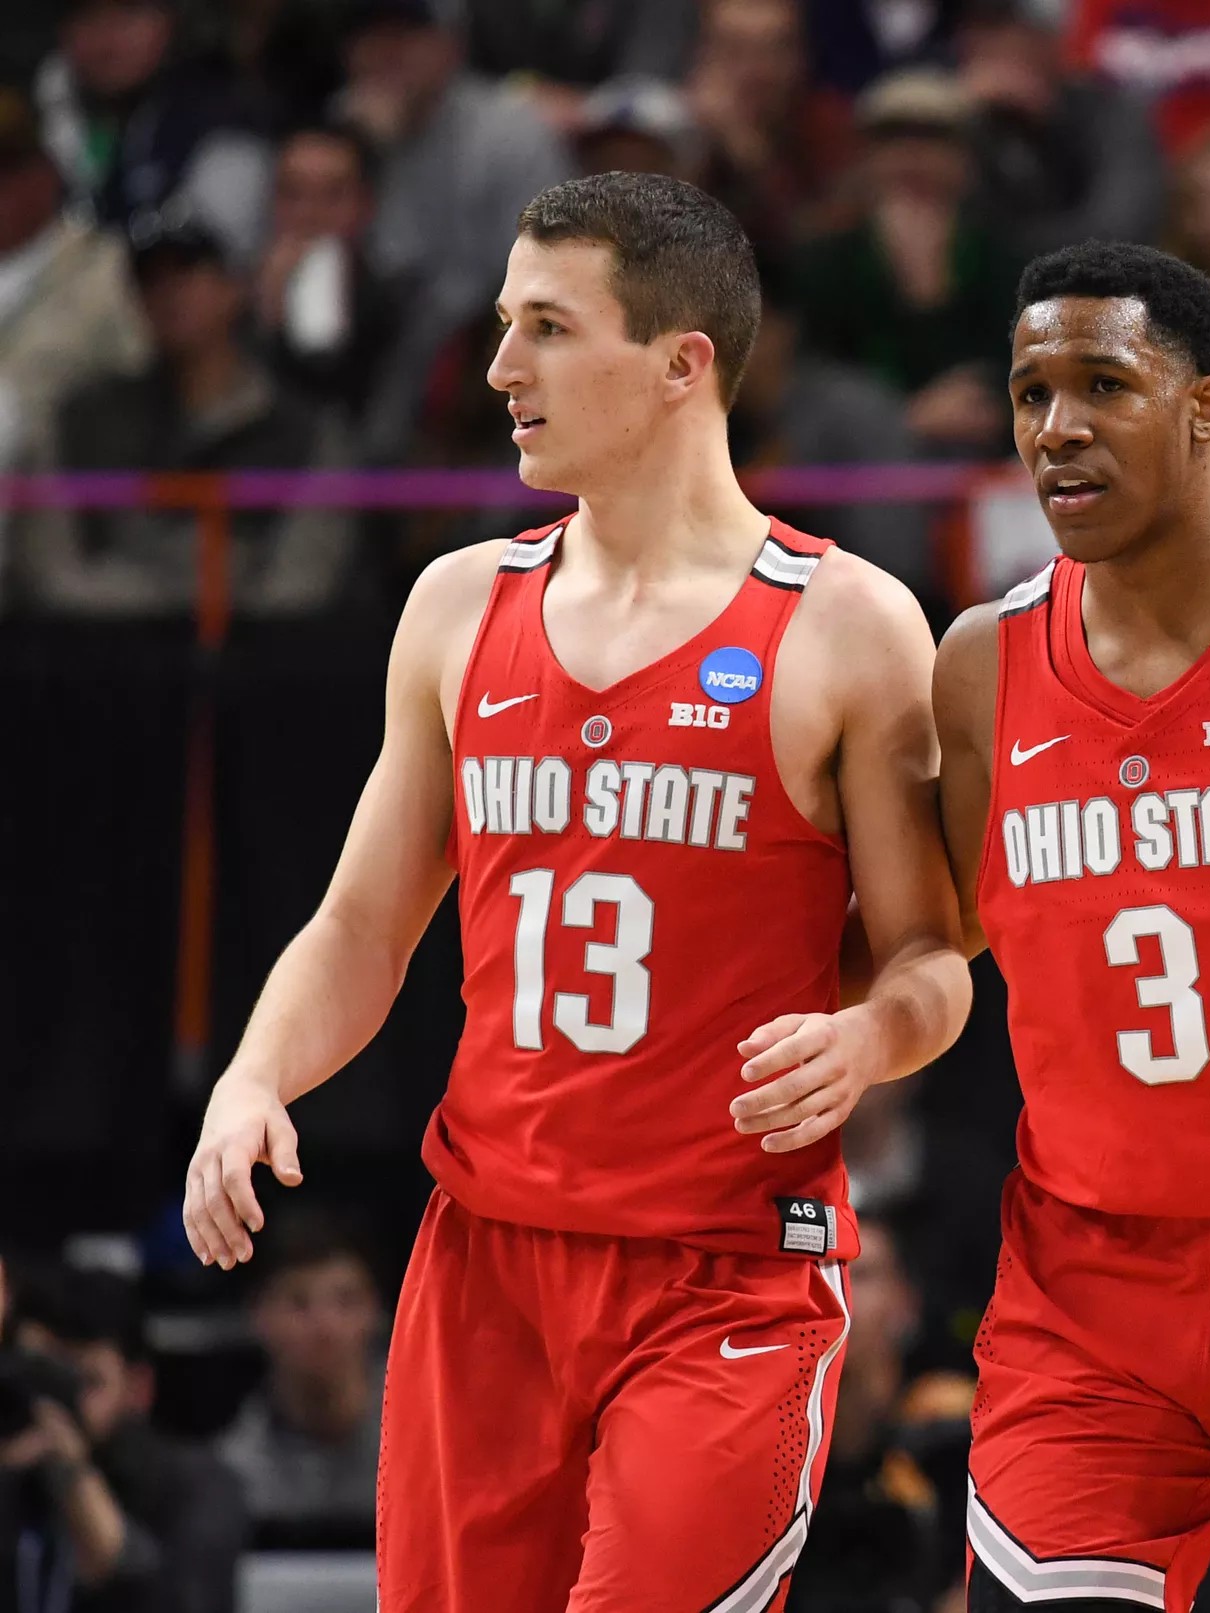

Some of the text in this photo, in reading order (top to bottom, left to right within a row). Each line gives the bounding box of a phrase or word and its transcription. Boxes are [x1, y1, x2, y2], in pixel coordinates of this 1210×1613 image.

[706, 671, 758, 691] NCAA
[461, 755, 757, 852] OHIO STATE
[1002, 796, 1122, 888] OHIO
[509, 868, 655, 1055] 13
[789, 1202, 817, 1219] 46
